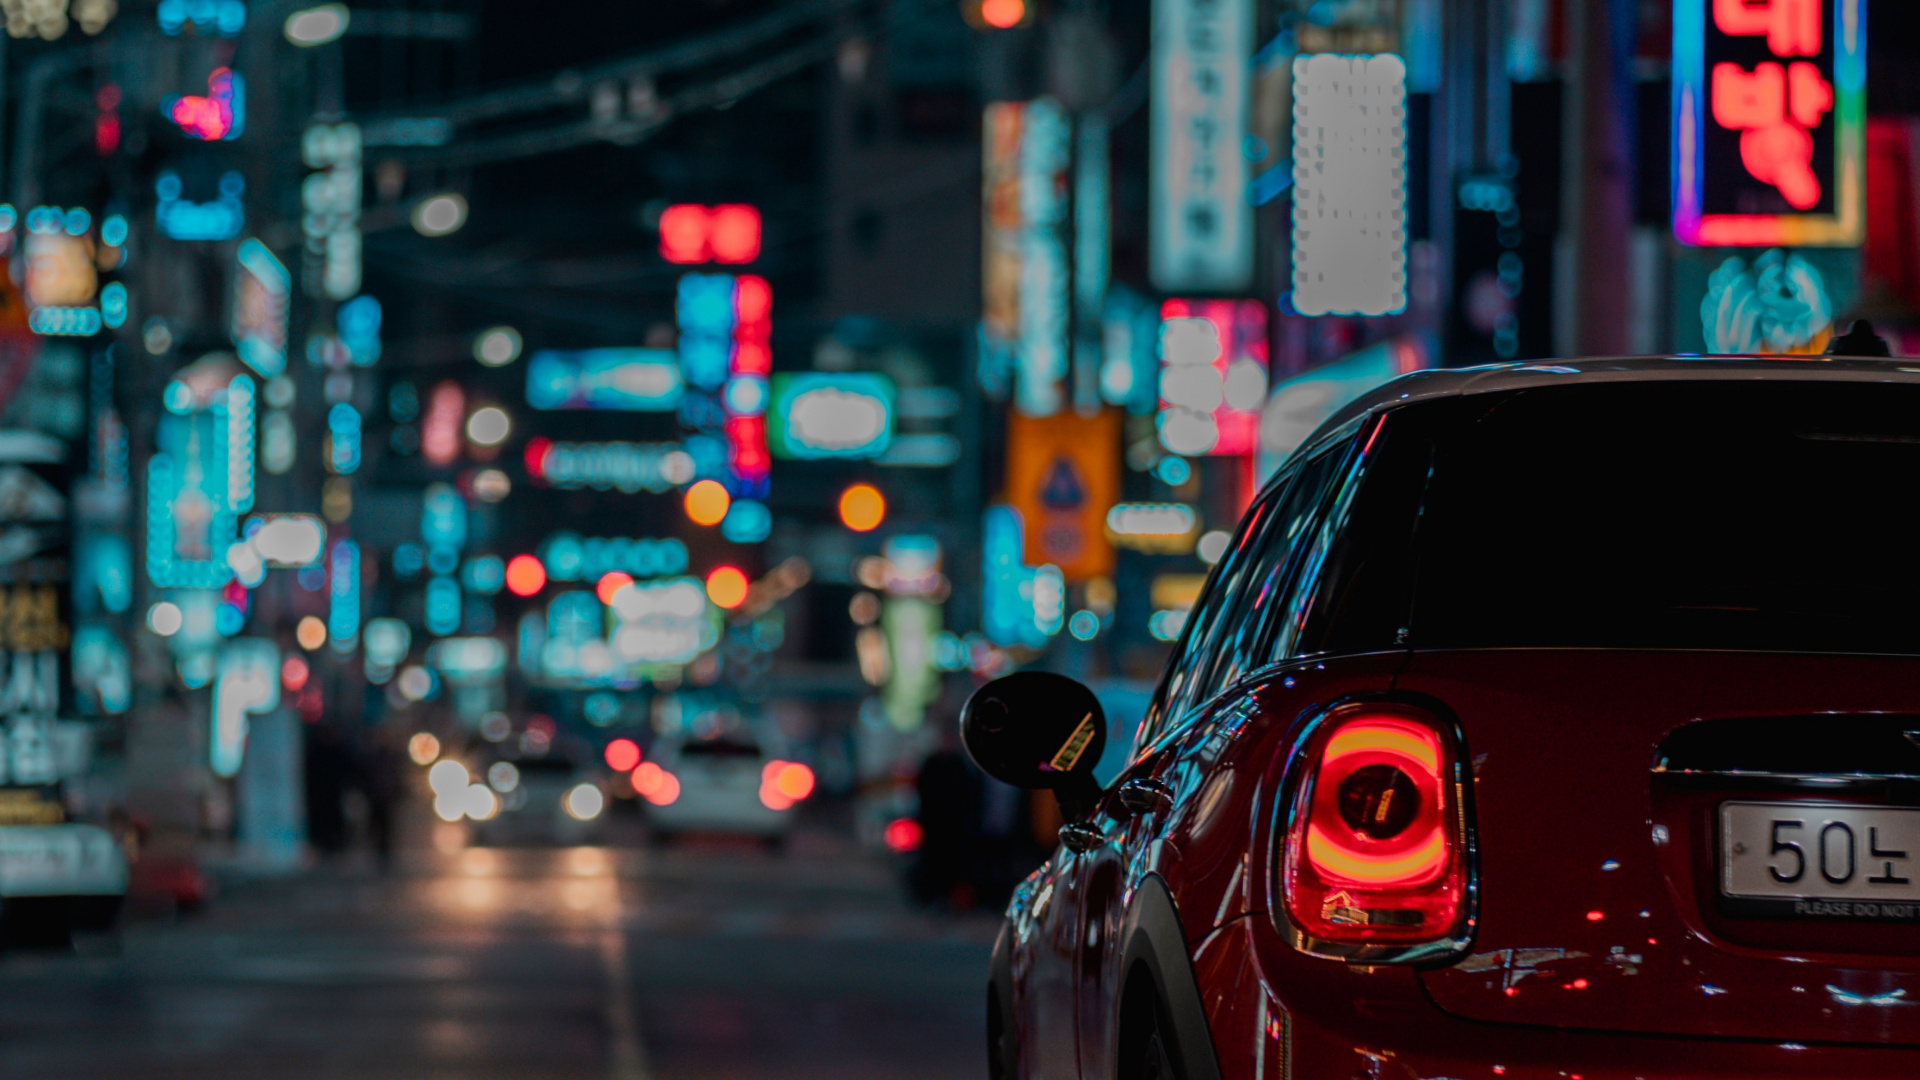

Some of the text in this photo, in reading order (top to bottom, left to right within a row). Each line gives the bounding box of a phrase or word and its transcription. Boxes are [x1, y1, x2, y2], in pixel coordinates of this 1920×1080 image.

[1768, 819, 1910, 885] 50노
[1795, 901, 1852, 916] PLEASE
[1853, 903, 1880, 917] DO
[1881, 904, 1914, 918] NOT
